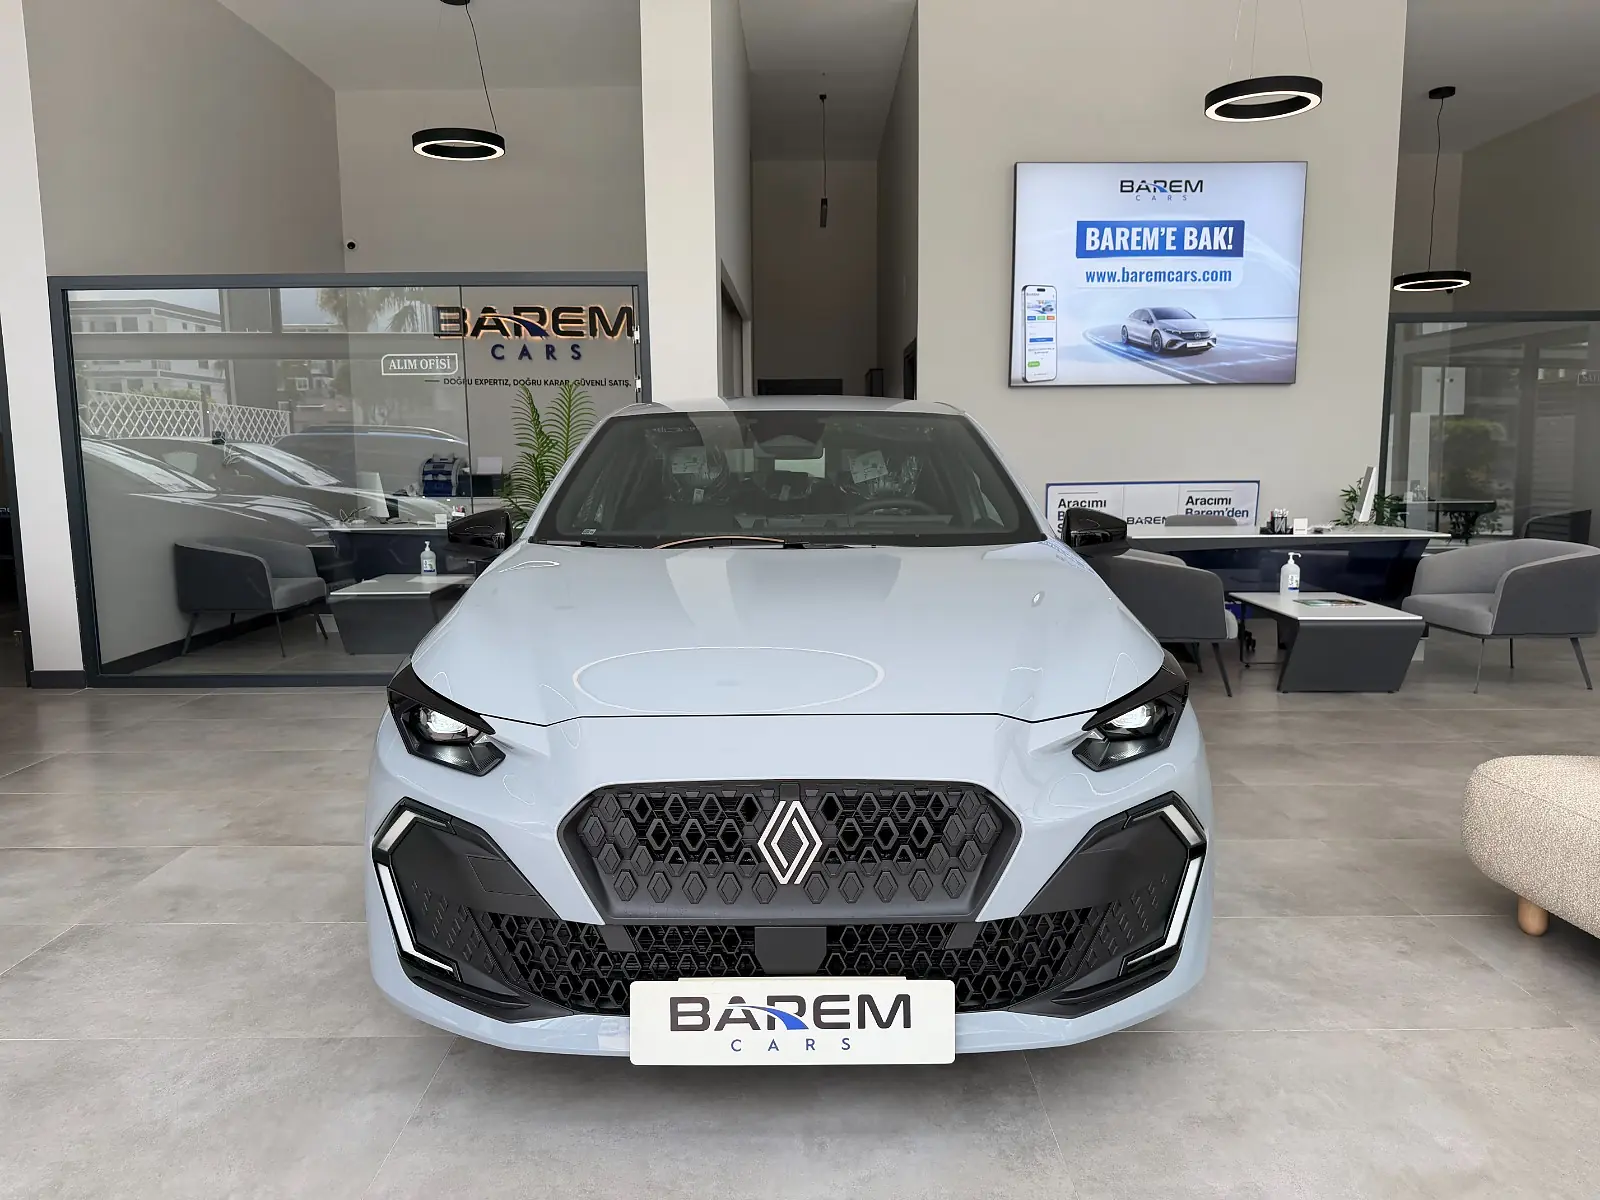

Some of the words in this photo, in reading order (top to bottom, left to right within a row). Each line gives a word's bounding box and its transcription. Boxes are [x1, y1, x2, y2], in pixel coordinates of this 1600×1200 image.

[1120, 180, 1204, 193] BAREM
[1085, 226, 1177, 251] BAREM'E
[1183, 226, 1234, 251] BAK!
[1085, 266, 1232, 283] www.baremcars.com
[436, 305, 634, 338] BAREM
[490, 343, 582, 361] CARS
[389, 357, 418, 370] ALIM
[420, 355, 451, 370] OFİSİ
[443, 377, 473, 386] DOĞRU
[513, 377, 542, 386] DOĞRU
[1058, 498, 1107, 509] Aracımı
[1185, 495, 1231, 506] Aracımı
[1185, 507, 1249, 518] Barem'den
[670, 993, 911, 1032] BAREM
[731, 1037, 851, 1052] CARS
